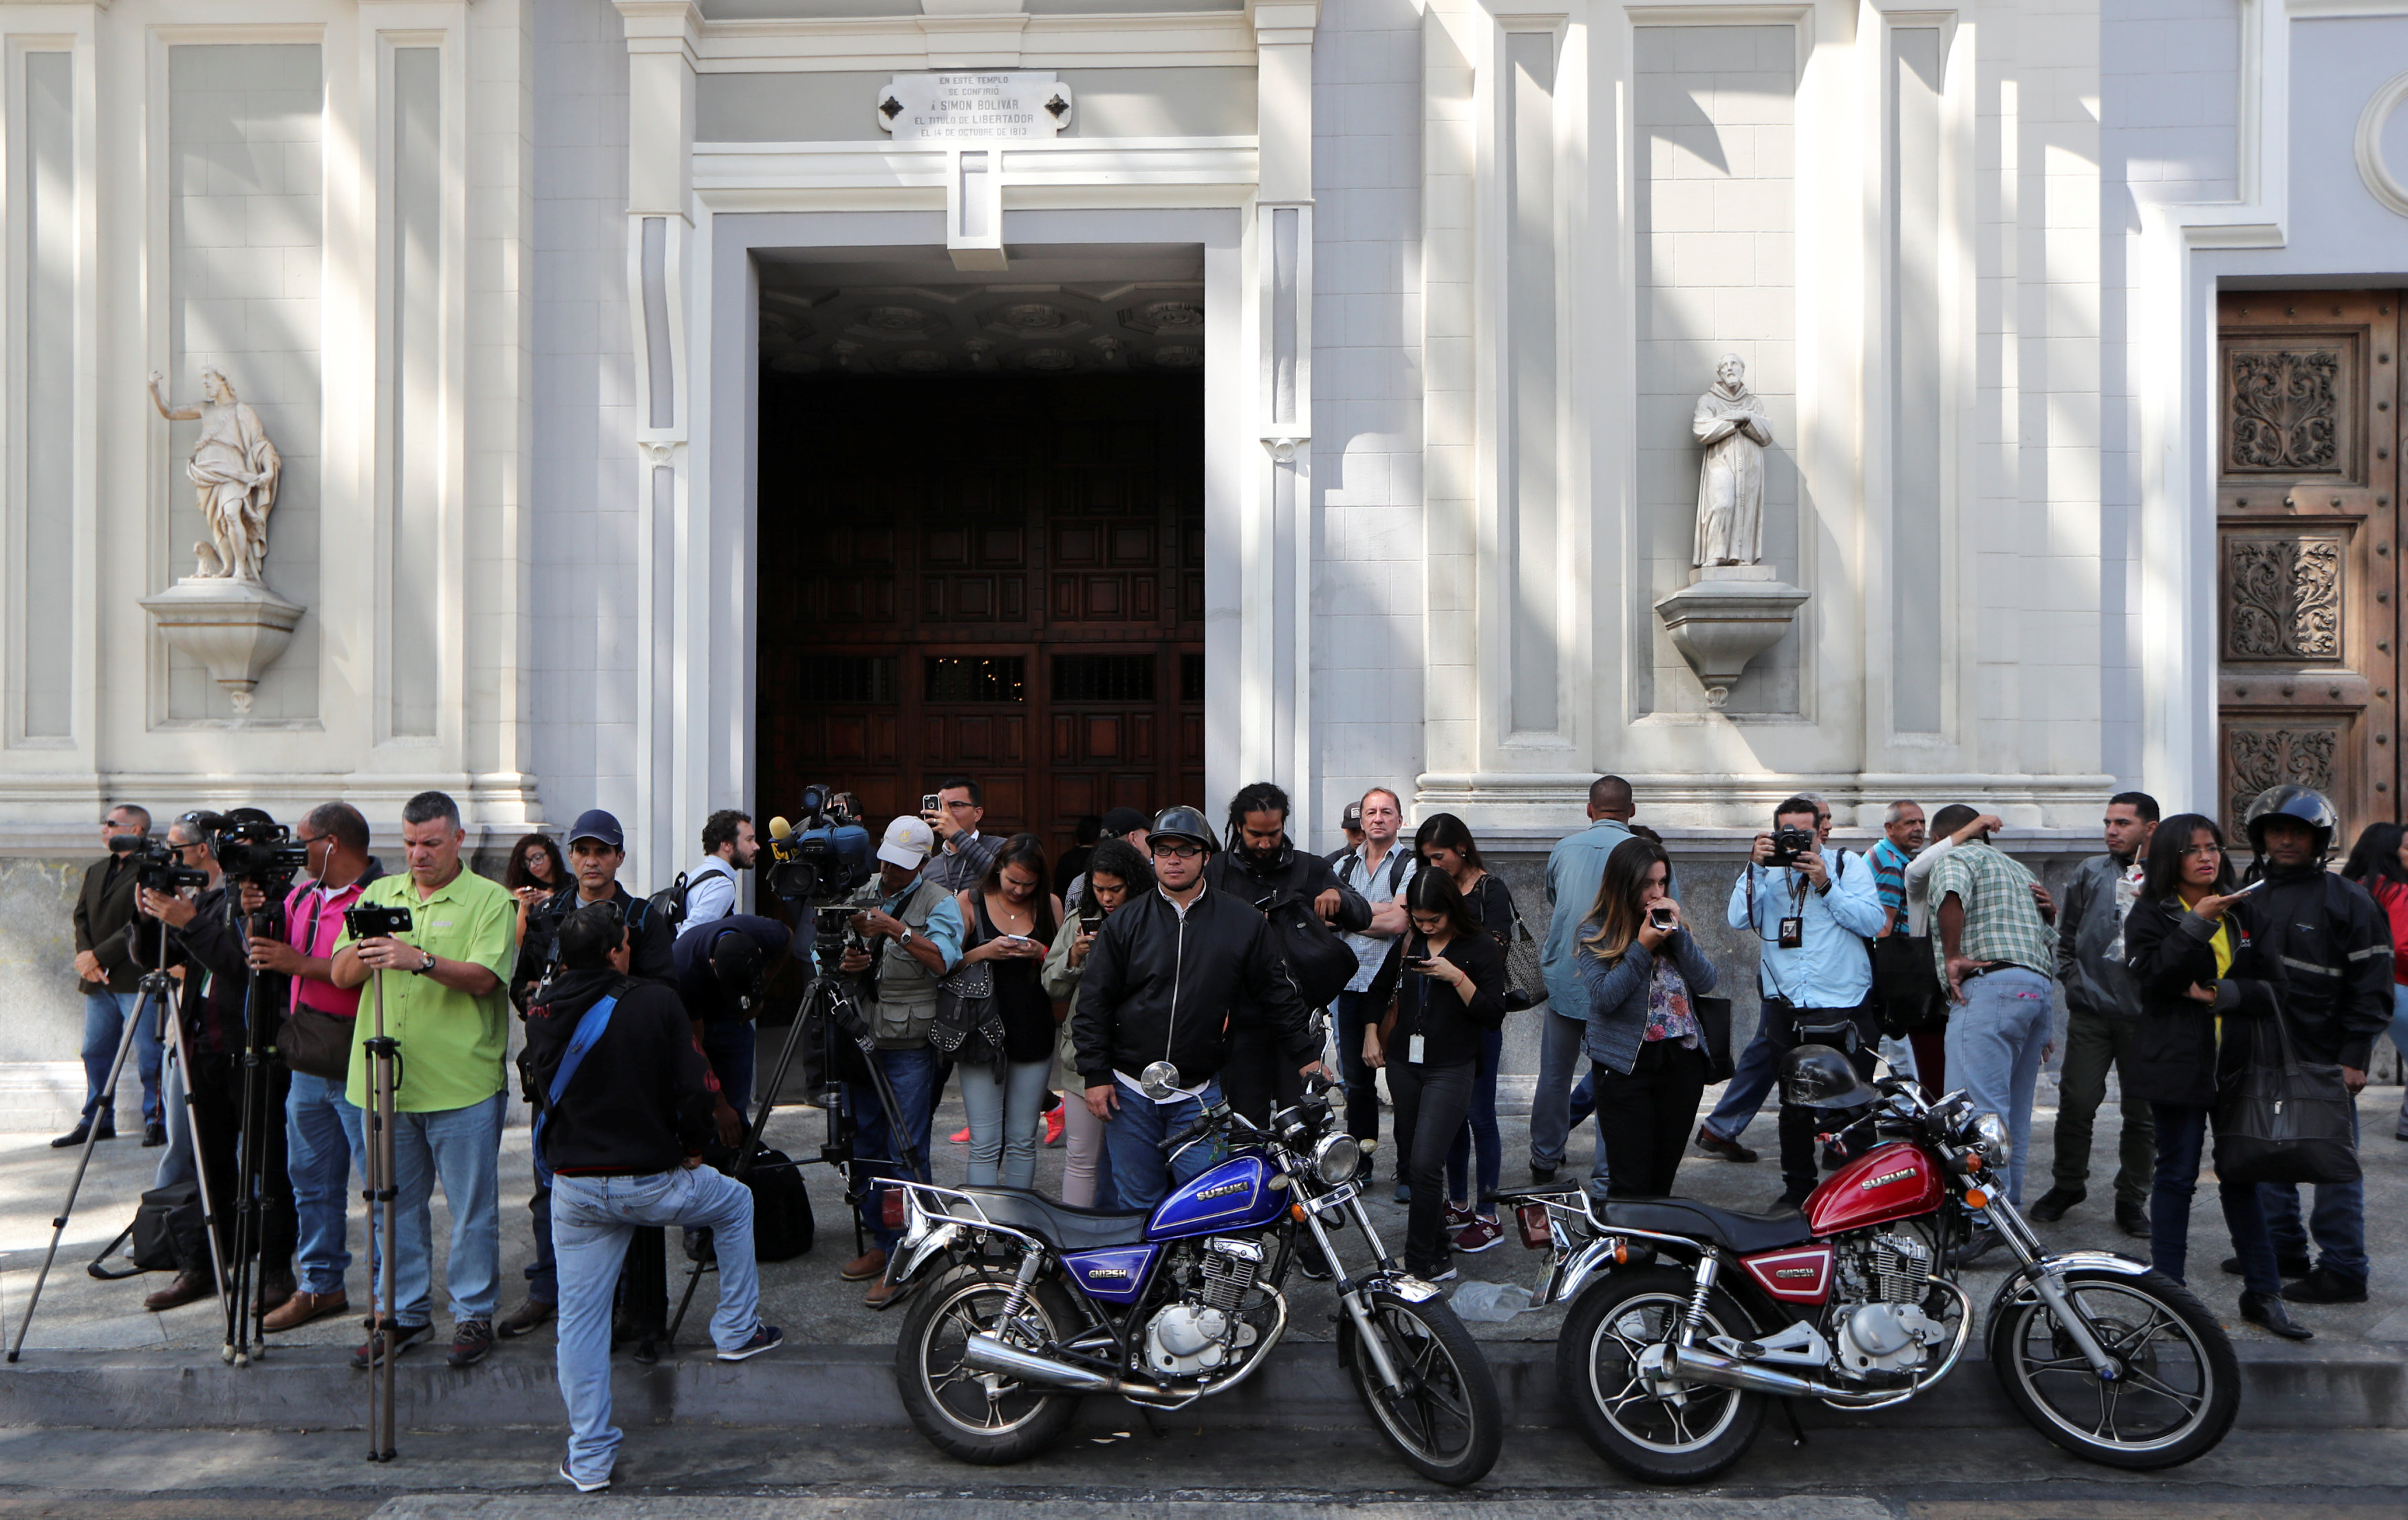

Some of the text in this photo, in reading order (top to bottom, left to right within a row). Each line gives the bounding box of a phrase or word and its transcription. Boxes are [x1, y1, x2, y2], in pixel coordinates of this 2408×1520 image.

[940, 100, 972, 111] SIMON
[978, 99, 1019, 110] BOLIVAR
[914, 114, 1033, 125] EL TITULO DE LIBERTADOR
[921, 129, 931, 137] EL
[934, 129, 942, 137] 14
[958, 128, 993, 136] OCTUBRE
[997, 128, 1007, 136] DE
[1010, 127, 1027, 136] 1813
[1861, 1167, 1917, 1191] SUZUKI
[1196, 1181, 1249, 1202] SUZUKI
[1445, 1213, 1459, 1225] N
[1481, 1226, 1495, 1239] N
[1088, 1269, 1127, 1279] GN125H
